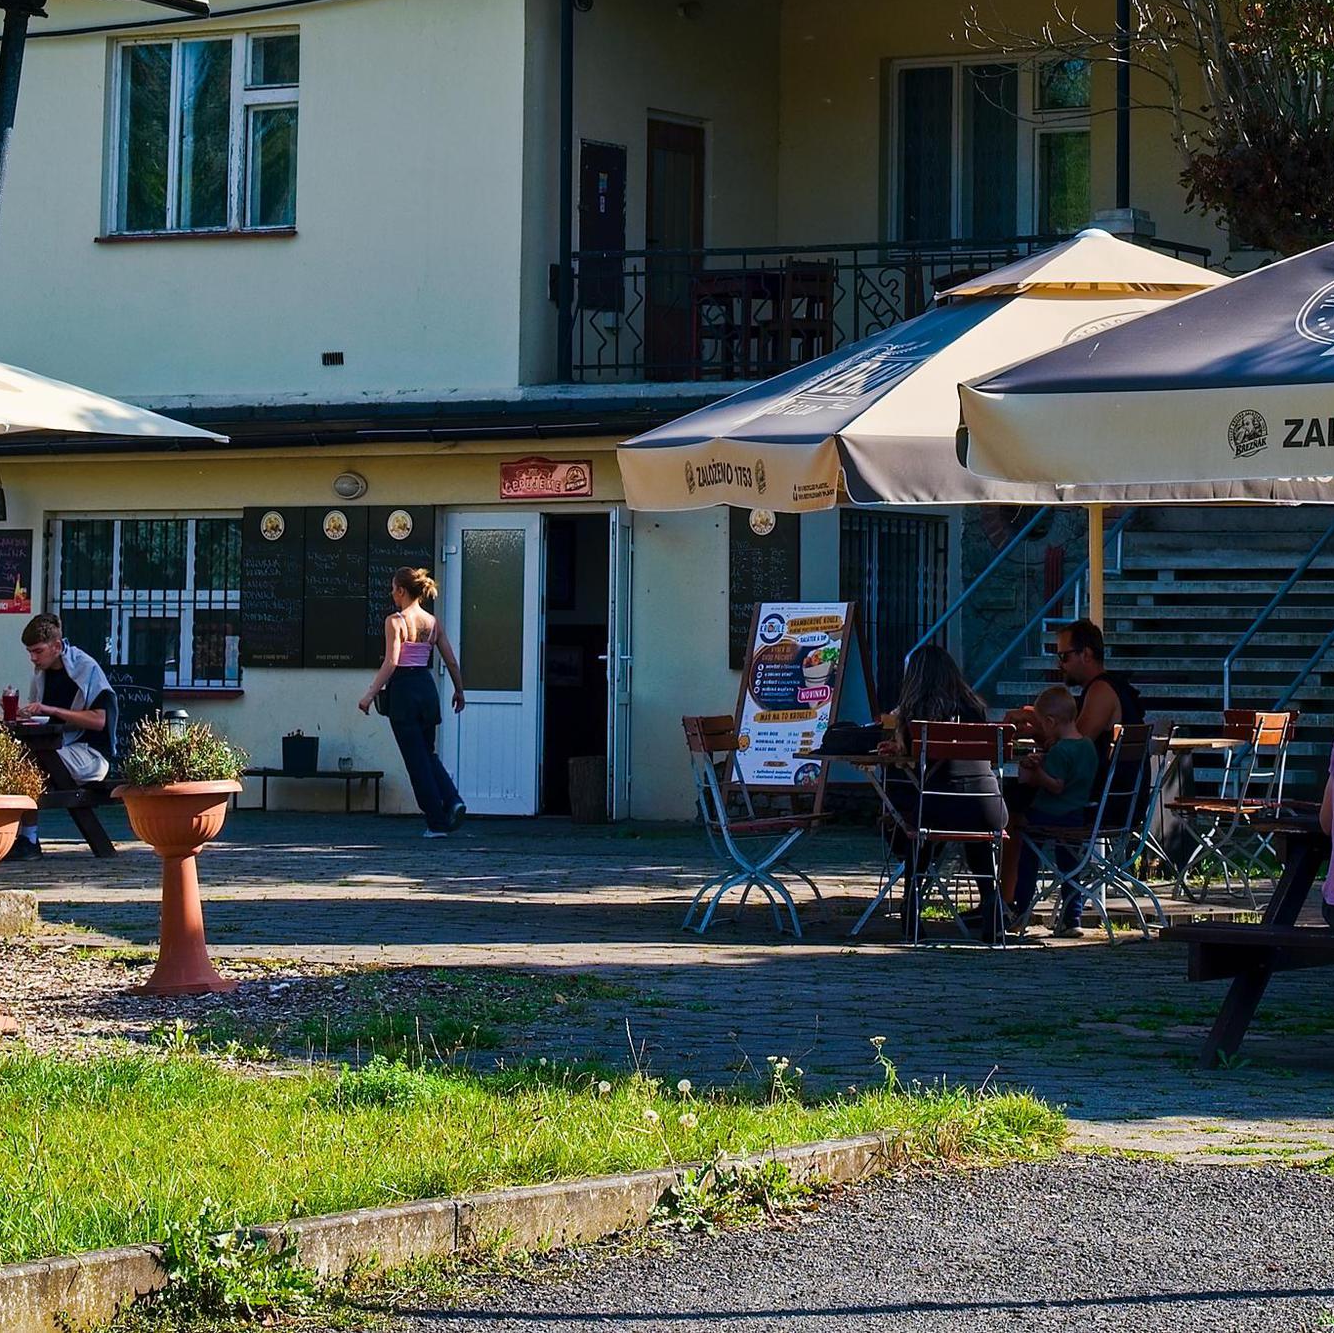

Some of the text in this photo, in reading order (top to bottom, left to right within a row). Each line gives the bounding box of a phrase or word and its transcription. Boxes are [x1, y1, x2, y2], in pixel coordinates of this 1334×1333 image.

[696, 458, 754, 488] ZALOŽENO 1753
[801, 689, 826, 700] NOVINKA
